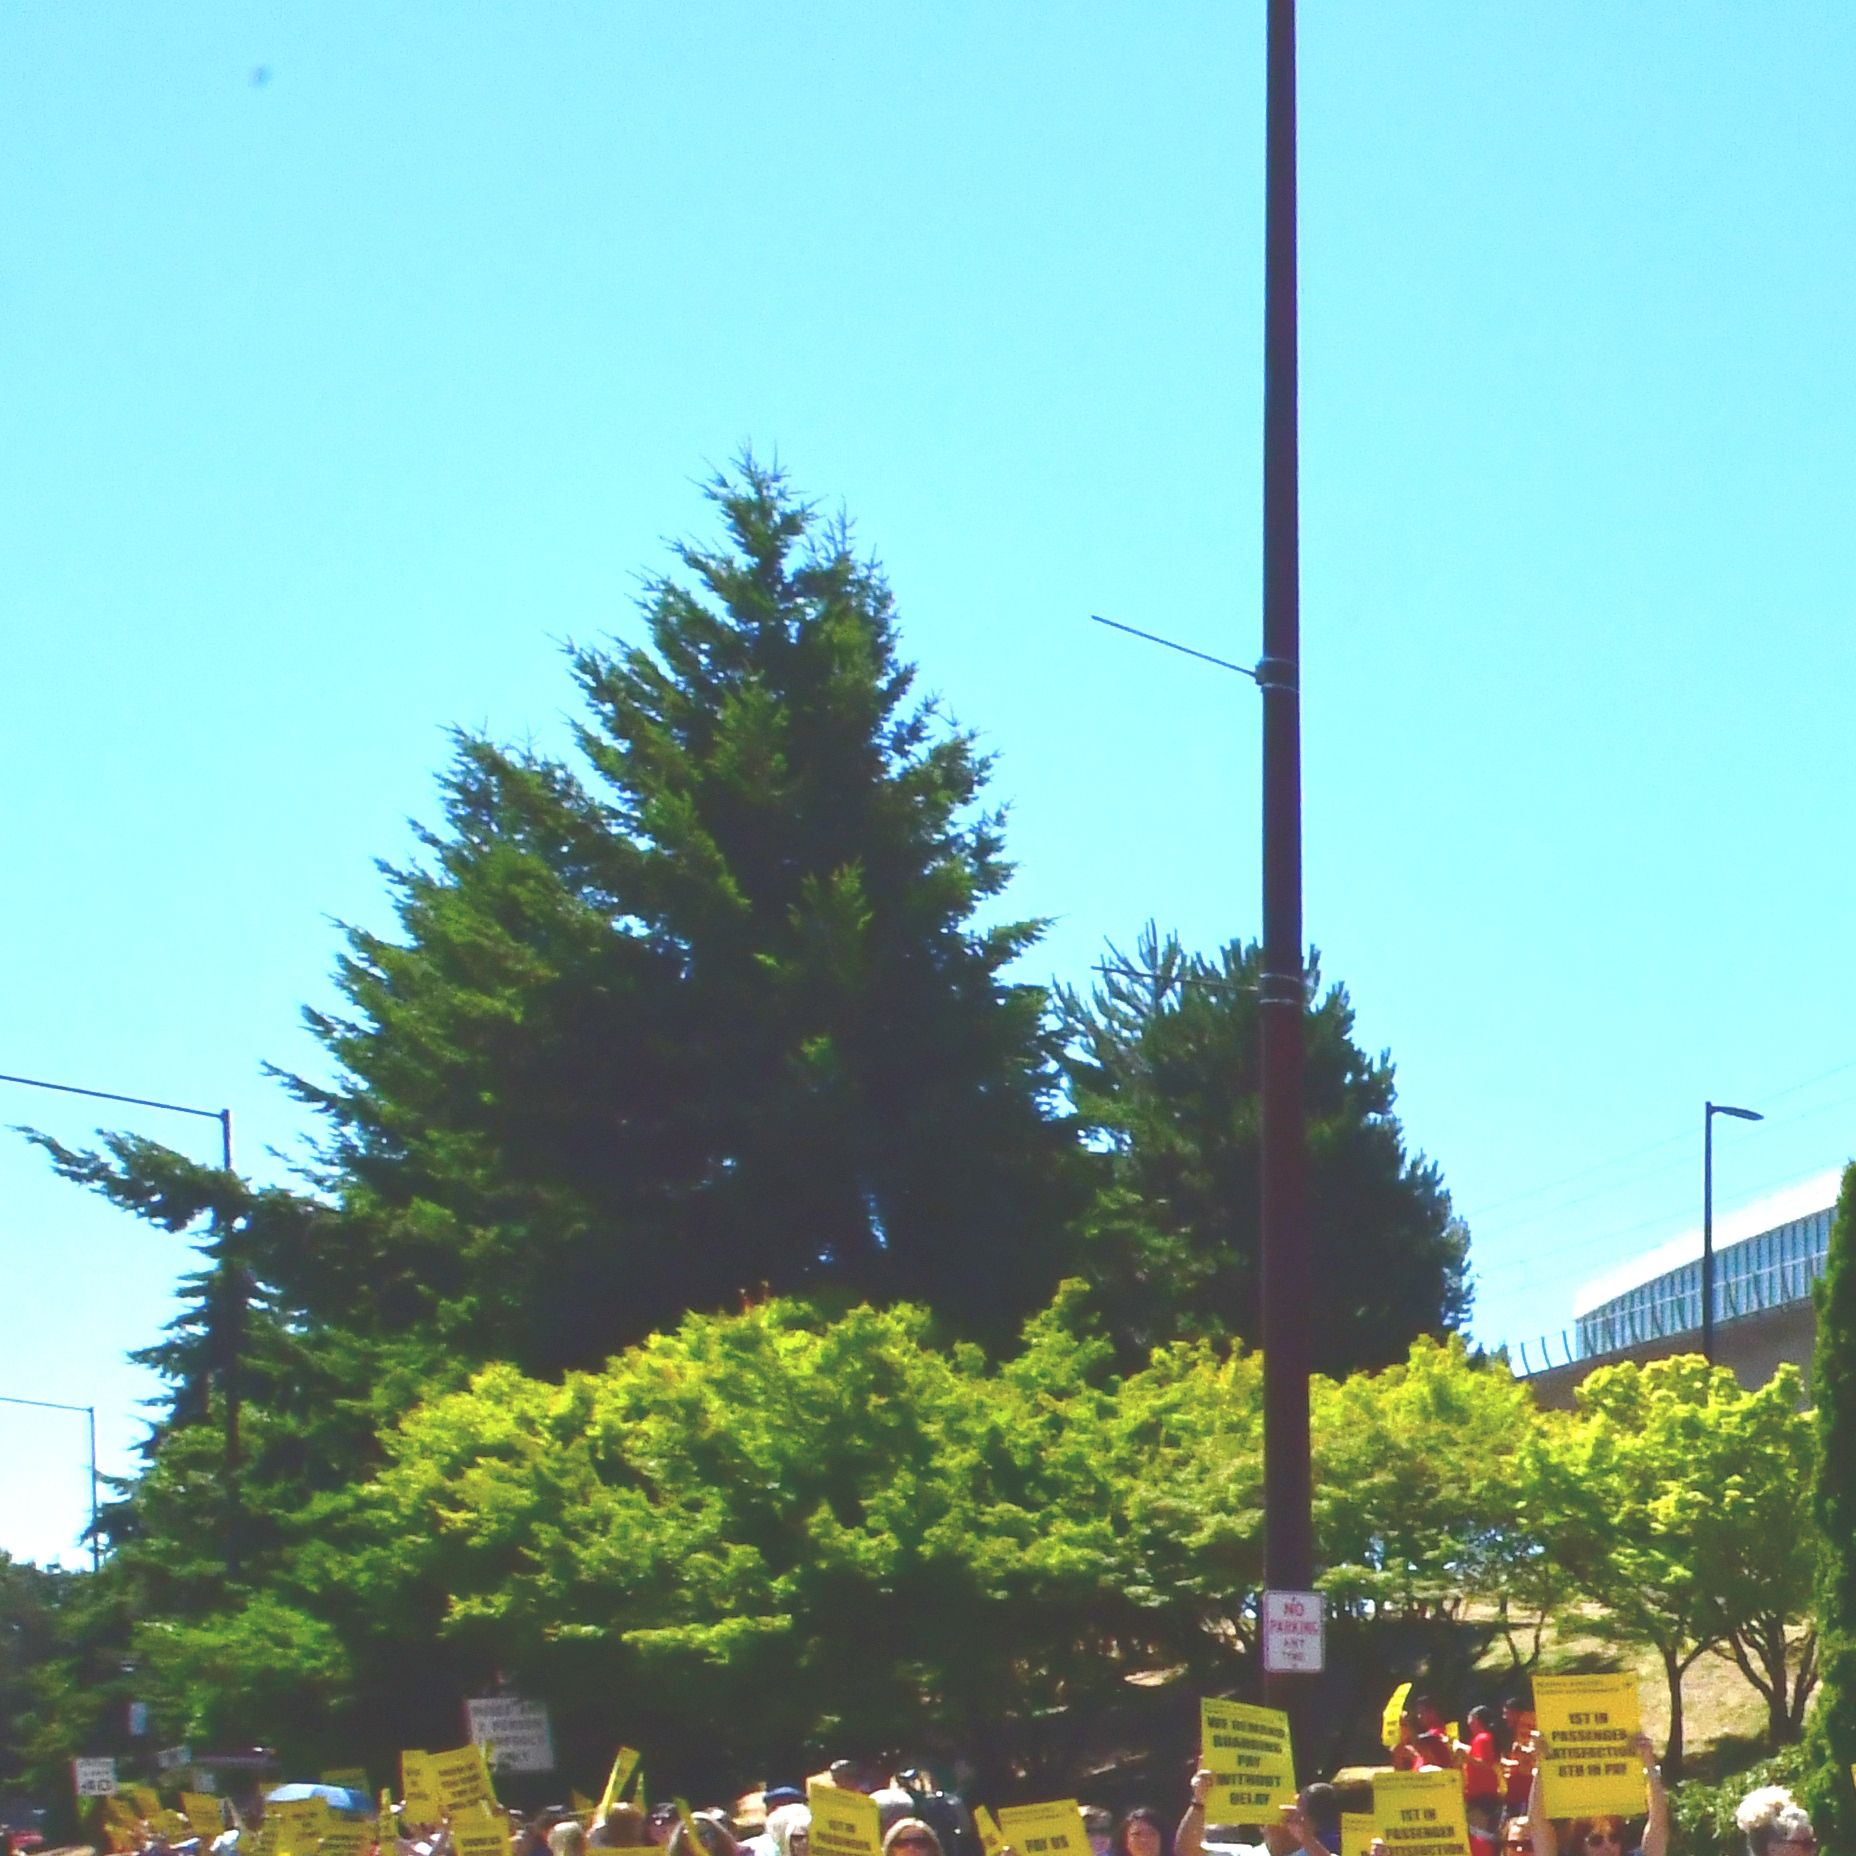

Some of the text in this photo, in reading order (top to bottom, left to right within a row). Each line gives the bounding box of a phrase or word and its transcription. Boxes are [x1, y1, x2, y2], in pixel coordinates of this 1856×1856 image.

[1284, 1602, 1304, 1617] NO
[1269, 1620, 1319, 1634] PARKING
[1568, 1712, 1609, 1725] 1ST IN
[1206, 1716, 1286, 1739] WE DEMAND
[1552, 1728, 1629, 1742] PASSENGER
[1212, 1735, 1283, 1754] BOARDING
[1236, 1754, 1261, 1768] PAY
[1587, 1764, 1601, 1776] IN
[1604, 1763, 1628, 1776] PAY
[1216, 1773, 1281, 1788] WITHOUT
[1229, 1792, 1270, 1805] DELAY
[1400, 1808, 1437, 1822] 1ST IN
[1385, 1826, 1455, 1840] PASSENGER
[1024, 1835, 1069, 1853] PAY US
